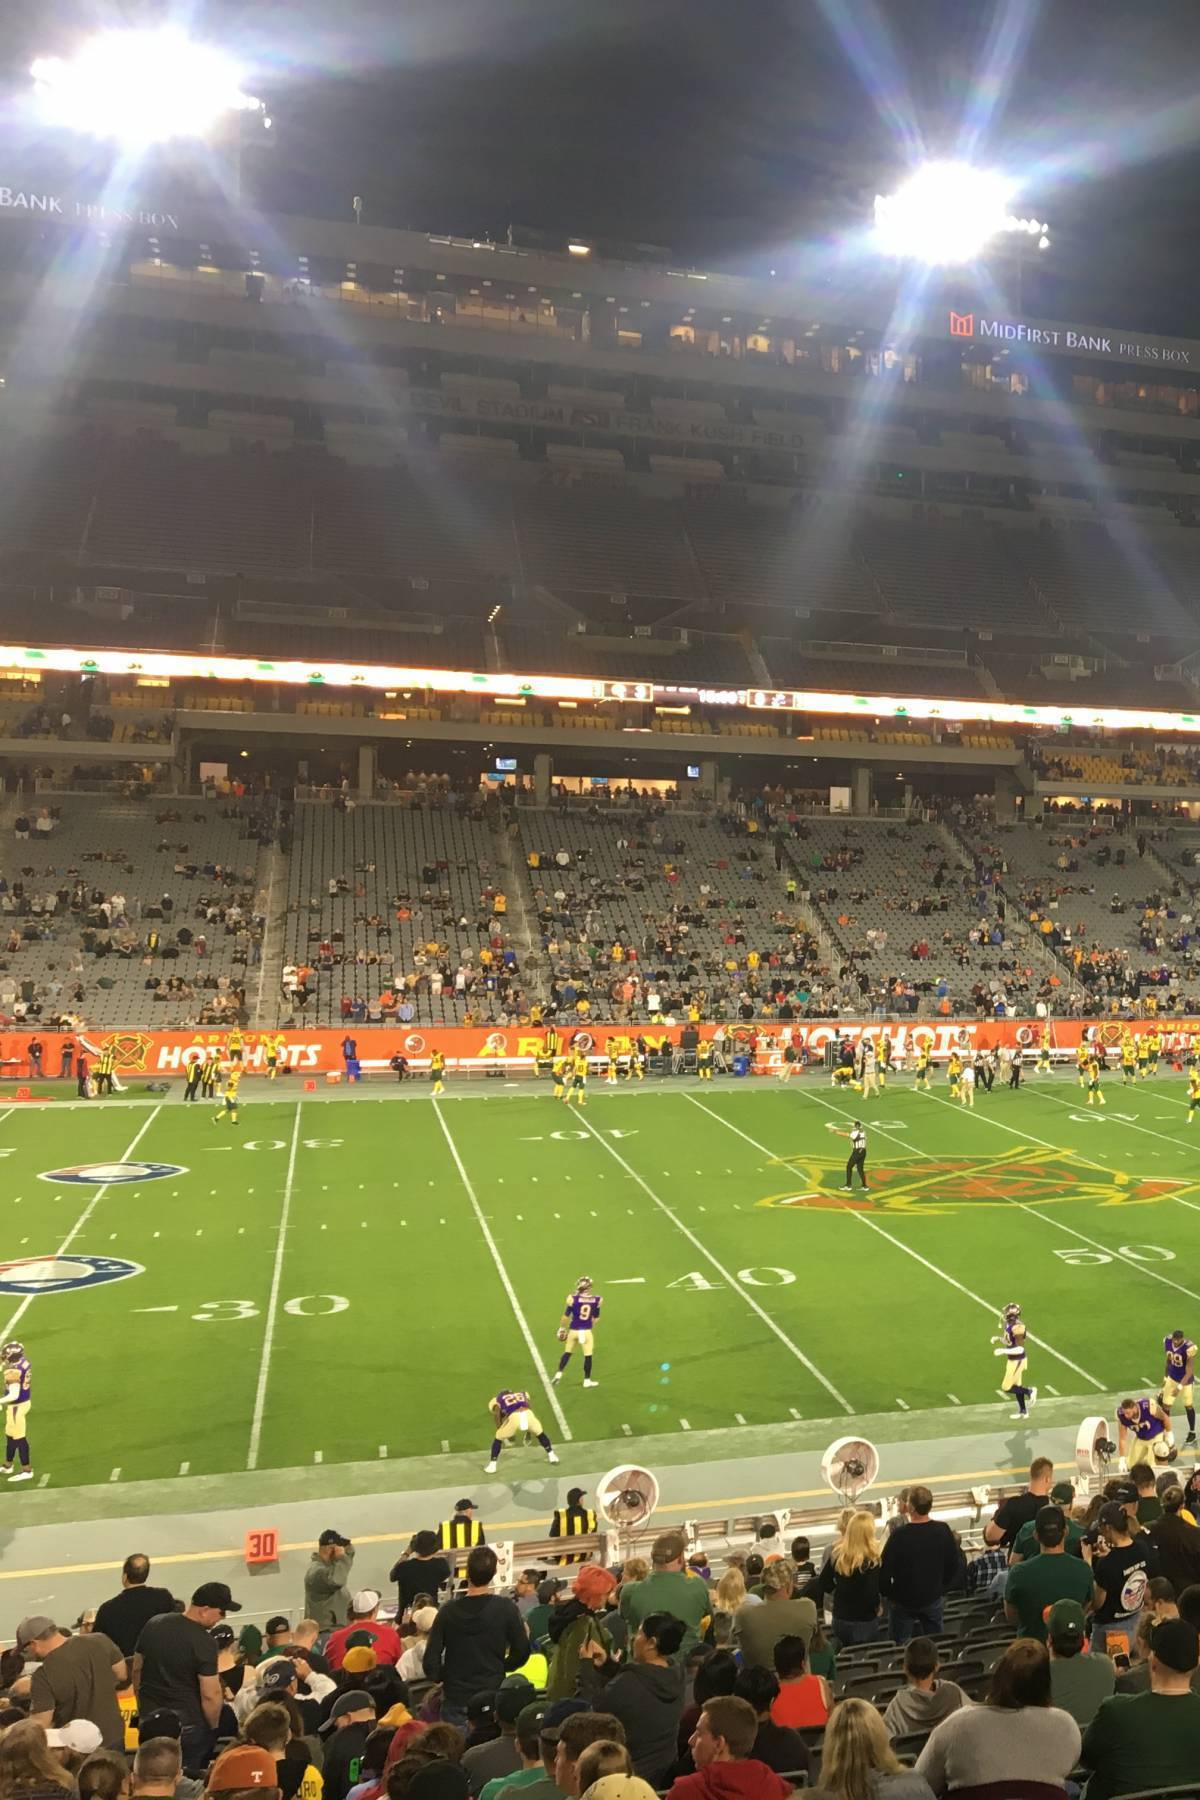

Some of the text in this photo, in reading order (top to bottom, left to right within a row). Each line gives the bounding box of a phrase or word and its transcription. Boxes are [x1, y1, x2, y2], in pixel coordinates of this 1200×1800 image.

[0, 187, 63, 214] BANK
[139, 211, 178, 230] BOX
[1066, 331, 1112, 353] BANK
[1119, 343, 1159, 360] PRESS
[1162, 351, 1190, 363] BOX
[191, 1294, 350, 1321] 30
[579, 1303, 592, 1320] 9
[249, 1533, 275, 1558] 30
[251, 1770, 264, 1783] T
